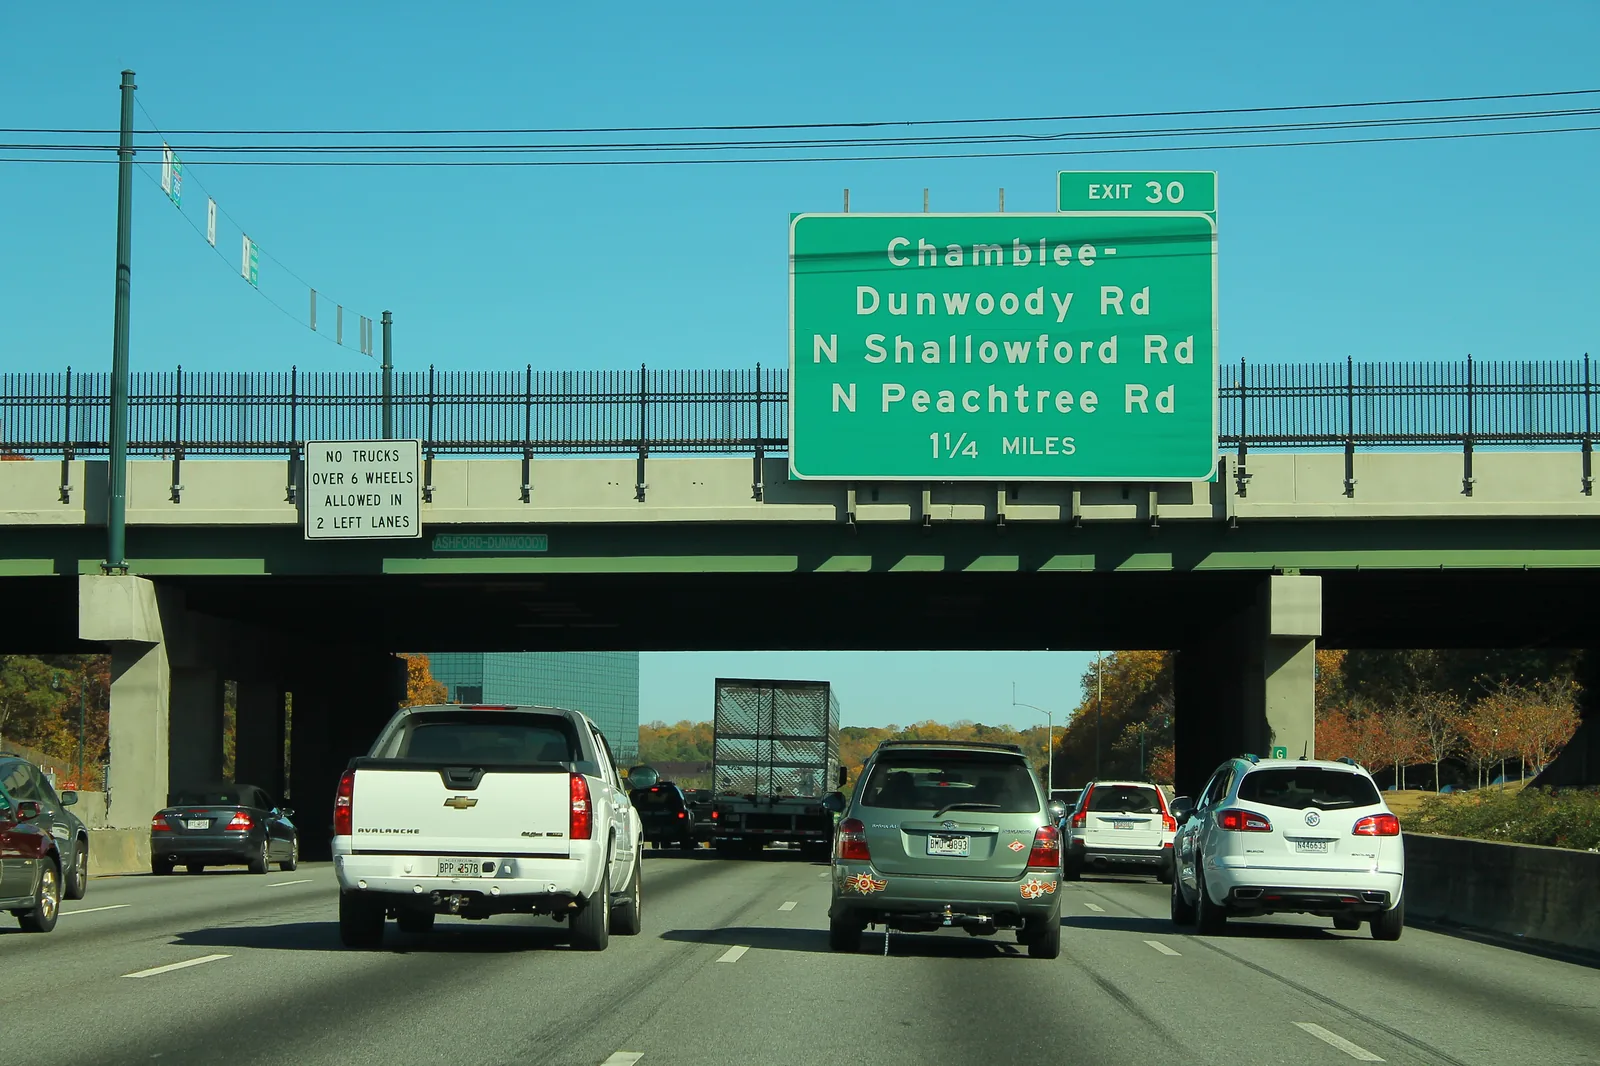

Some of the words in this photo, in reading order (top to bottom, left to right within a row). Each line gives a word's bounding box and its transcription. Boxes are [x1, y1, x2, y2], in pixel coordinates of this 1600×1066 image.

[1088, 183, 1132, 200] EXIT
[1145, 181, 1185, 204] 30
[887, 236, 1118, 267] Chamblee-
[856, 286, 1074, 323] Dunwoody
[1100, 286, 1150, 315] Rd
[813, 334, 837, 364] N
[864, 334, 1118, 364] Shallowford
[1144, 334, 1194, 364] Rd
[832, 383, 857, 413] N
[881, 383, 1099, 414] Peachtree
[1125, 383, 1175, 414] Rd
[1002, 436, 1076, 456] MILES
[326, 451, 343, 463] NO
[353, 449, 400, 463] TRUCKS
[312, 472, 344, 485] OVER
[351, 472, 358, 485] 6
[365, 471, 413, 484] WHEELS
[325, 494, 381, 507] ALLOWED
[390, 494, 402, 506] IN
[316, 517, 324, 529] 2
[333, 516, 362, 528] LEFT
[371, 515, 410, 528] LANES
[434, 536, 545, 549] ASHFORD-DUNWOODY
[439, 862, 454, 873] BPP
[459, 863, 479, 874] 2578
